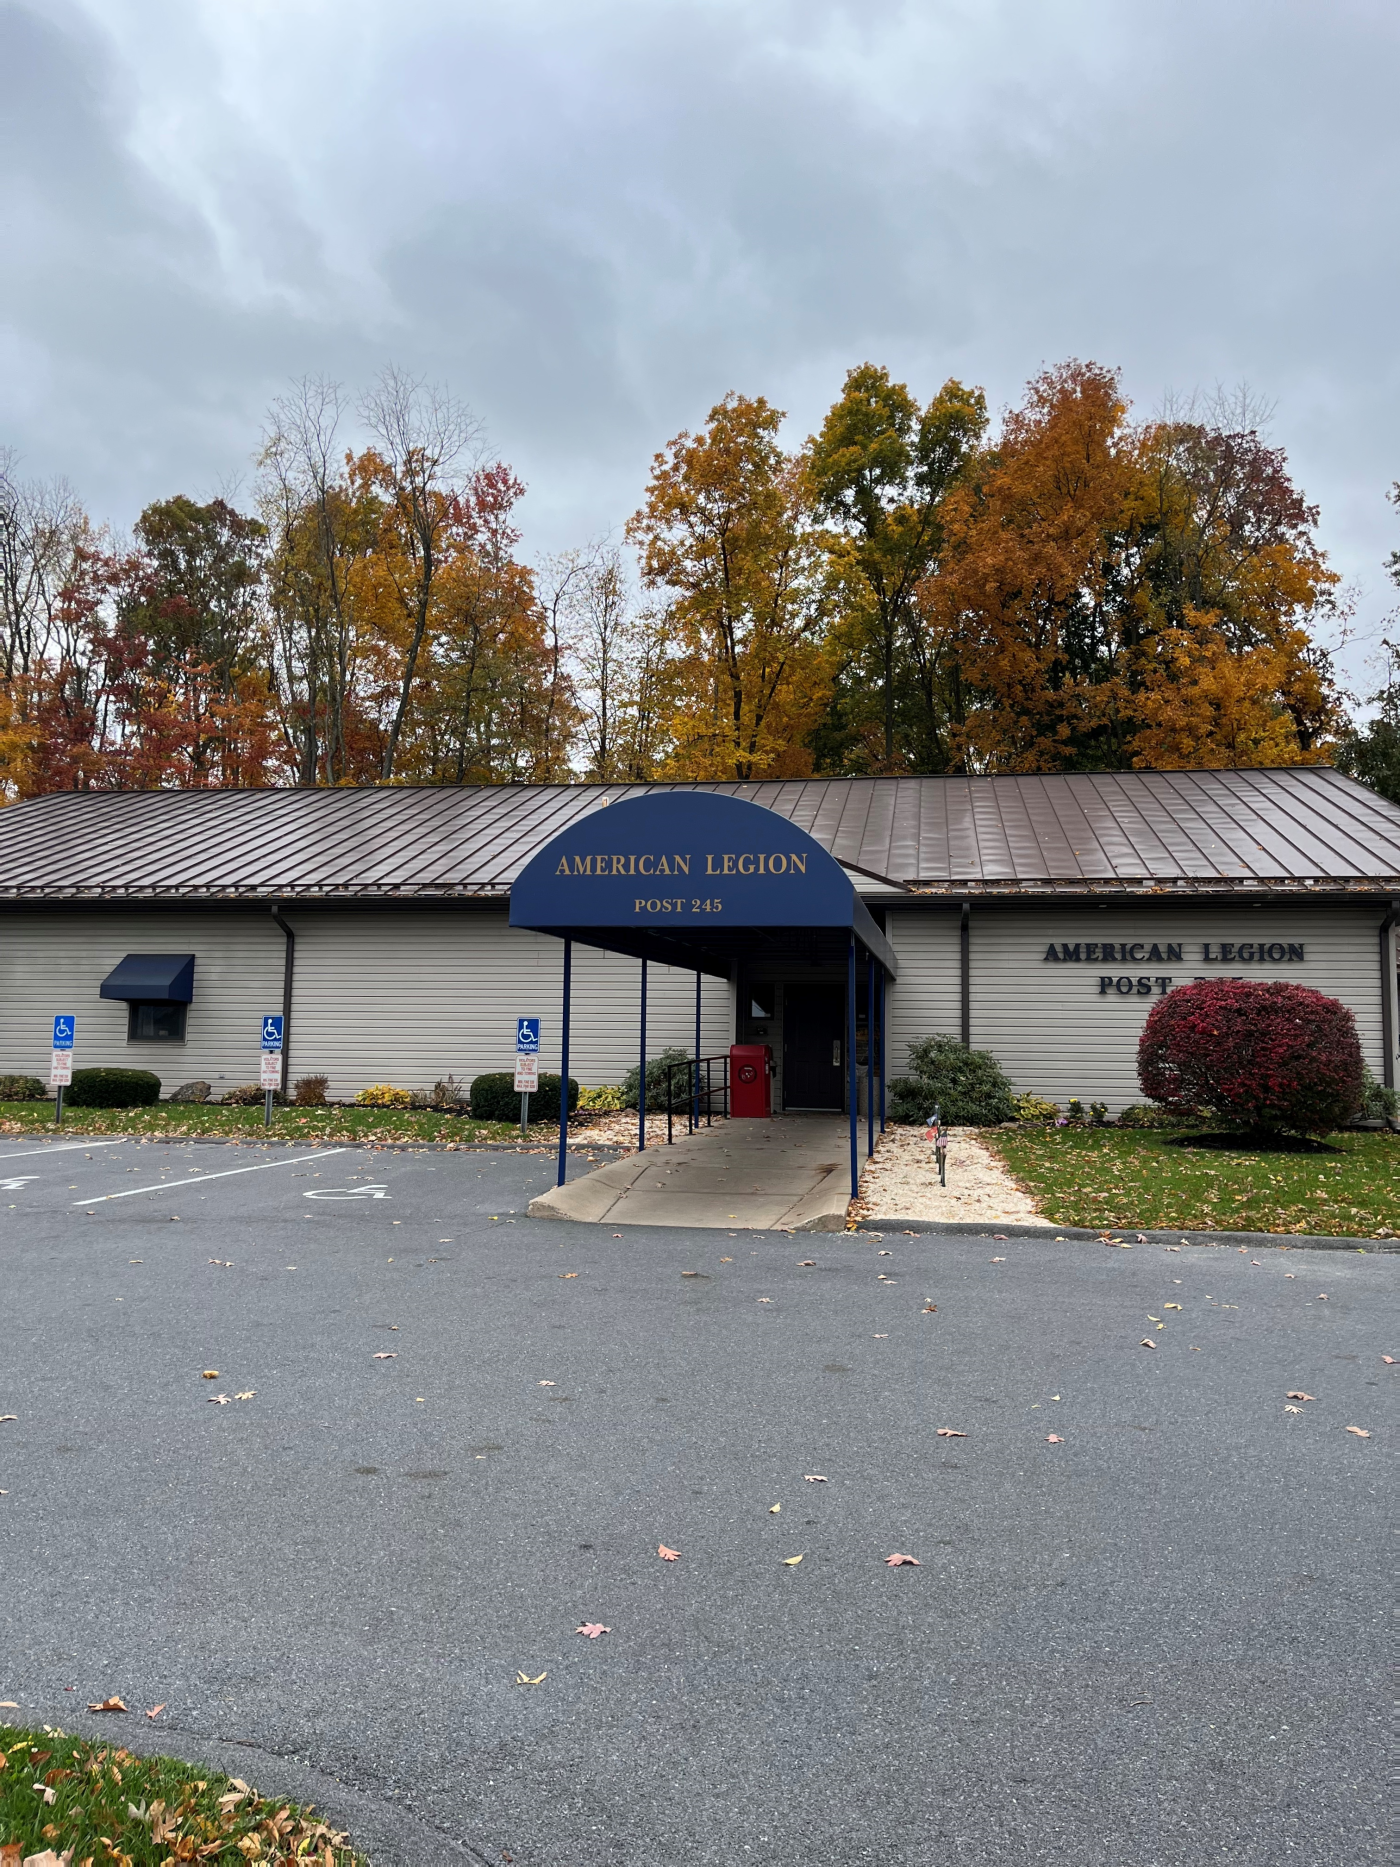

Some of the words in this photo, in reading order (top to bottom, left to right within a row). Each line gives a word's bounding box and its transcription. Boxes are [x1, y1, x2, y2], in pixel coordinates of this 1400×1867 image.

[555, 855, 691, 875] AMERICAN
[705, 853, 808, 875] LEGION
[634, 899, 686, 913] POST
[691, 898, 723, 913] 245
[1043, 943, 1184, 962] AMERICAN
[1202, 943, 1305, 962] LEGION
[1098, 976, 1173, 995] POST
